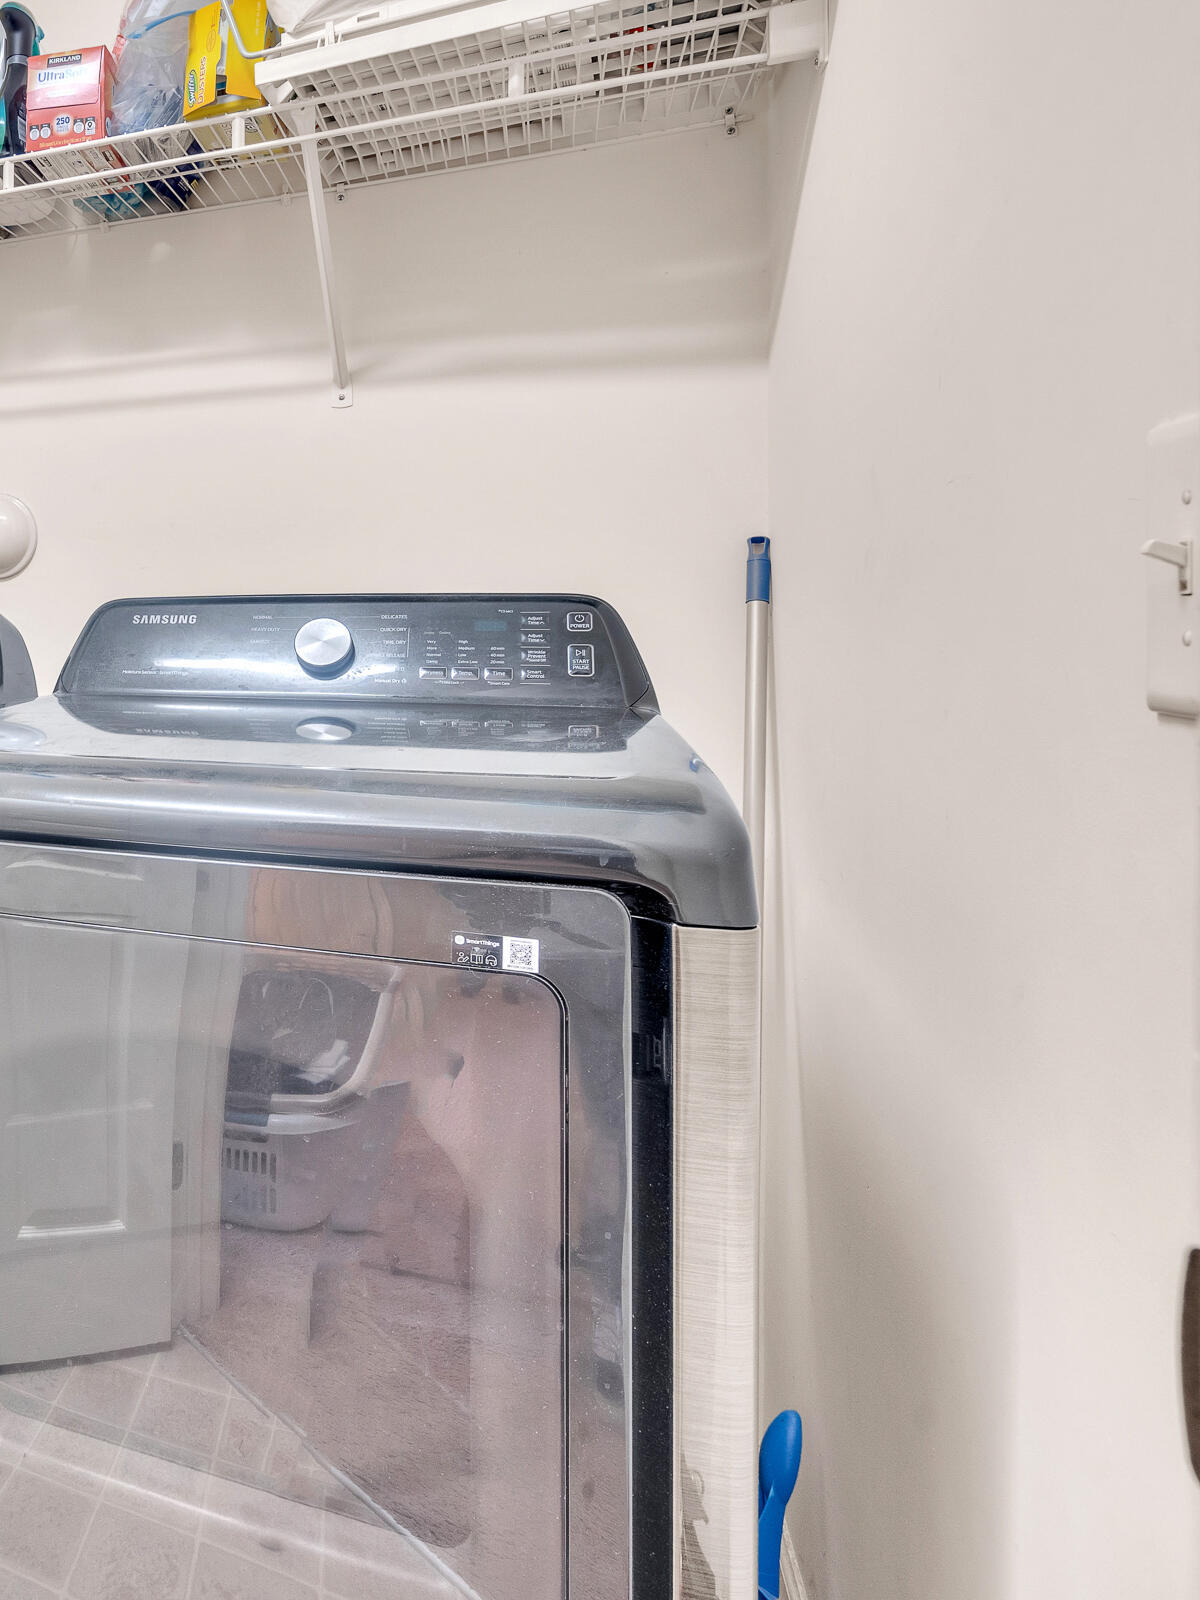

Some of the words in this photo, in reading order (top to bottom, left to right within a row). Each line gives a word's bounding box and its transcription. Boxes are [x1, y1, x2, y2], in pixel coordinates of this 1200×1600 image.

[48, 54, 81, 64] KIRKLAND
[56, 116, 70, 125] 250
[132, 614, 198, 624] SAMSUNG
